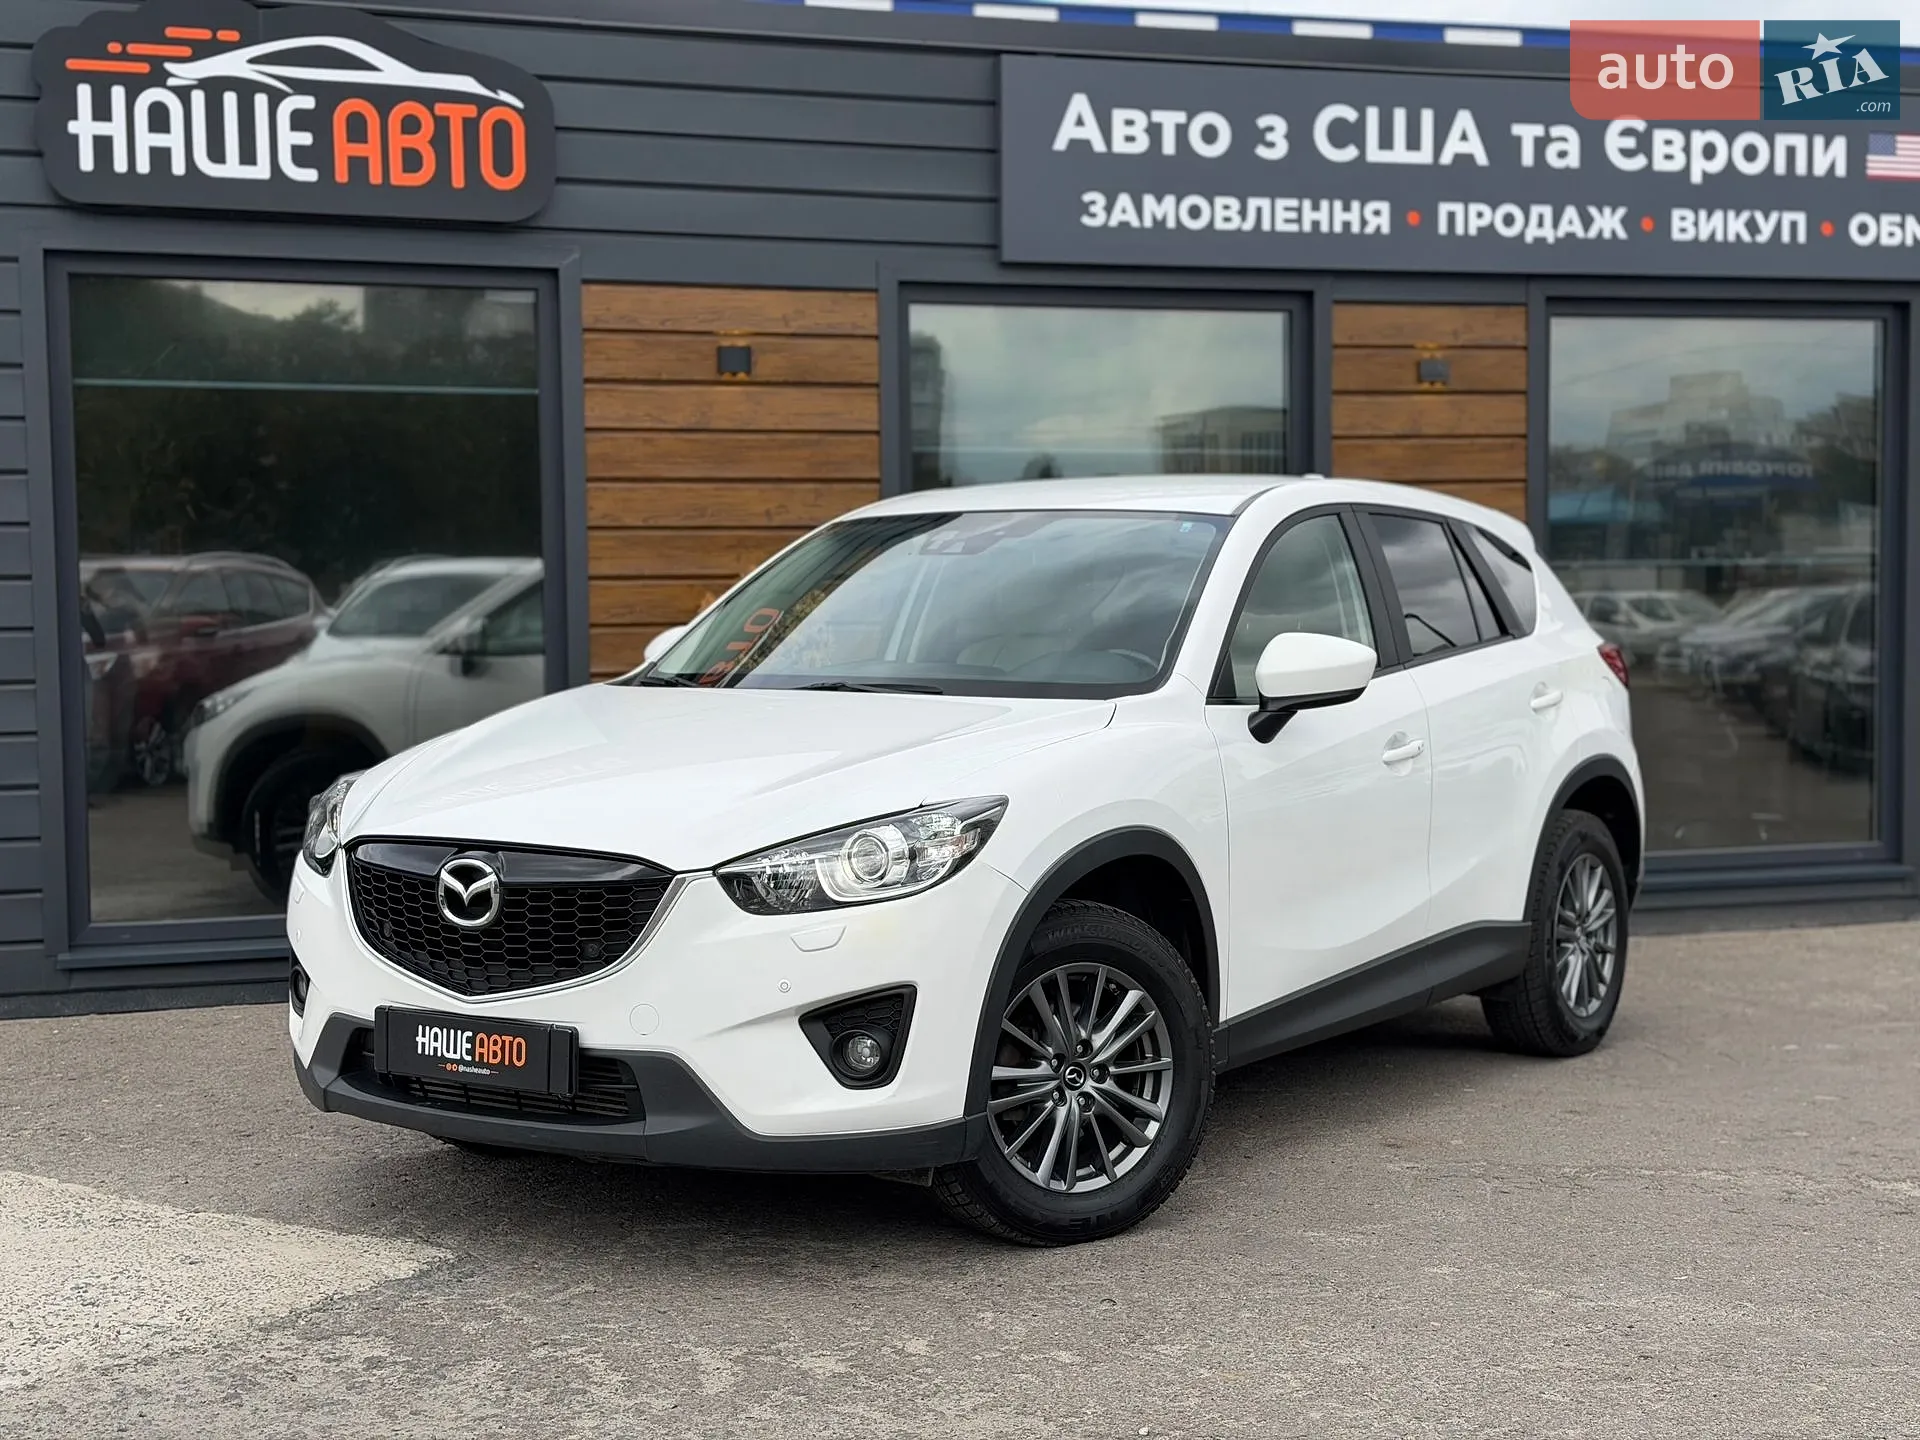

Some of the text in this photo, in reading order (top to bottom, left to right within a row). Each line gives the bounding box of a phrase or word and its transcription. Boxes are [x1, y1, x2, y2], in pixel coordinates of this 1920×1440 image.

[67, 83, 526, 190] НАШЕ АВТО
[1312, 103, 1490, 166] США
[1510, 122, 1581, 169] та
[1604, 115, 1848, 184] Європи
[1080, 190, 1391, 235] ЗАМОВЛЕННЯ
[1437, 202, 1628, 244] ПРОДАЖ
[1670, 208, 1807, 244] ВИКУП
[415, 1024, 526, 1067] НАШЕ АВТО
